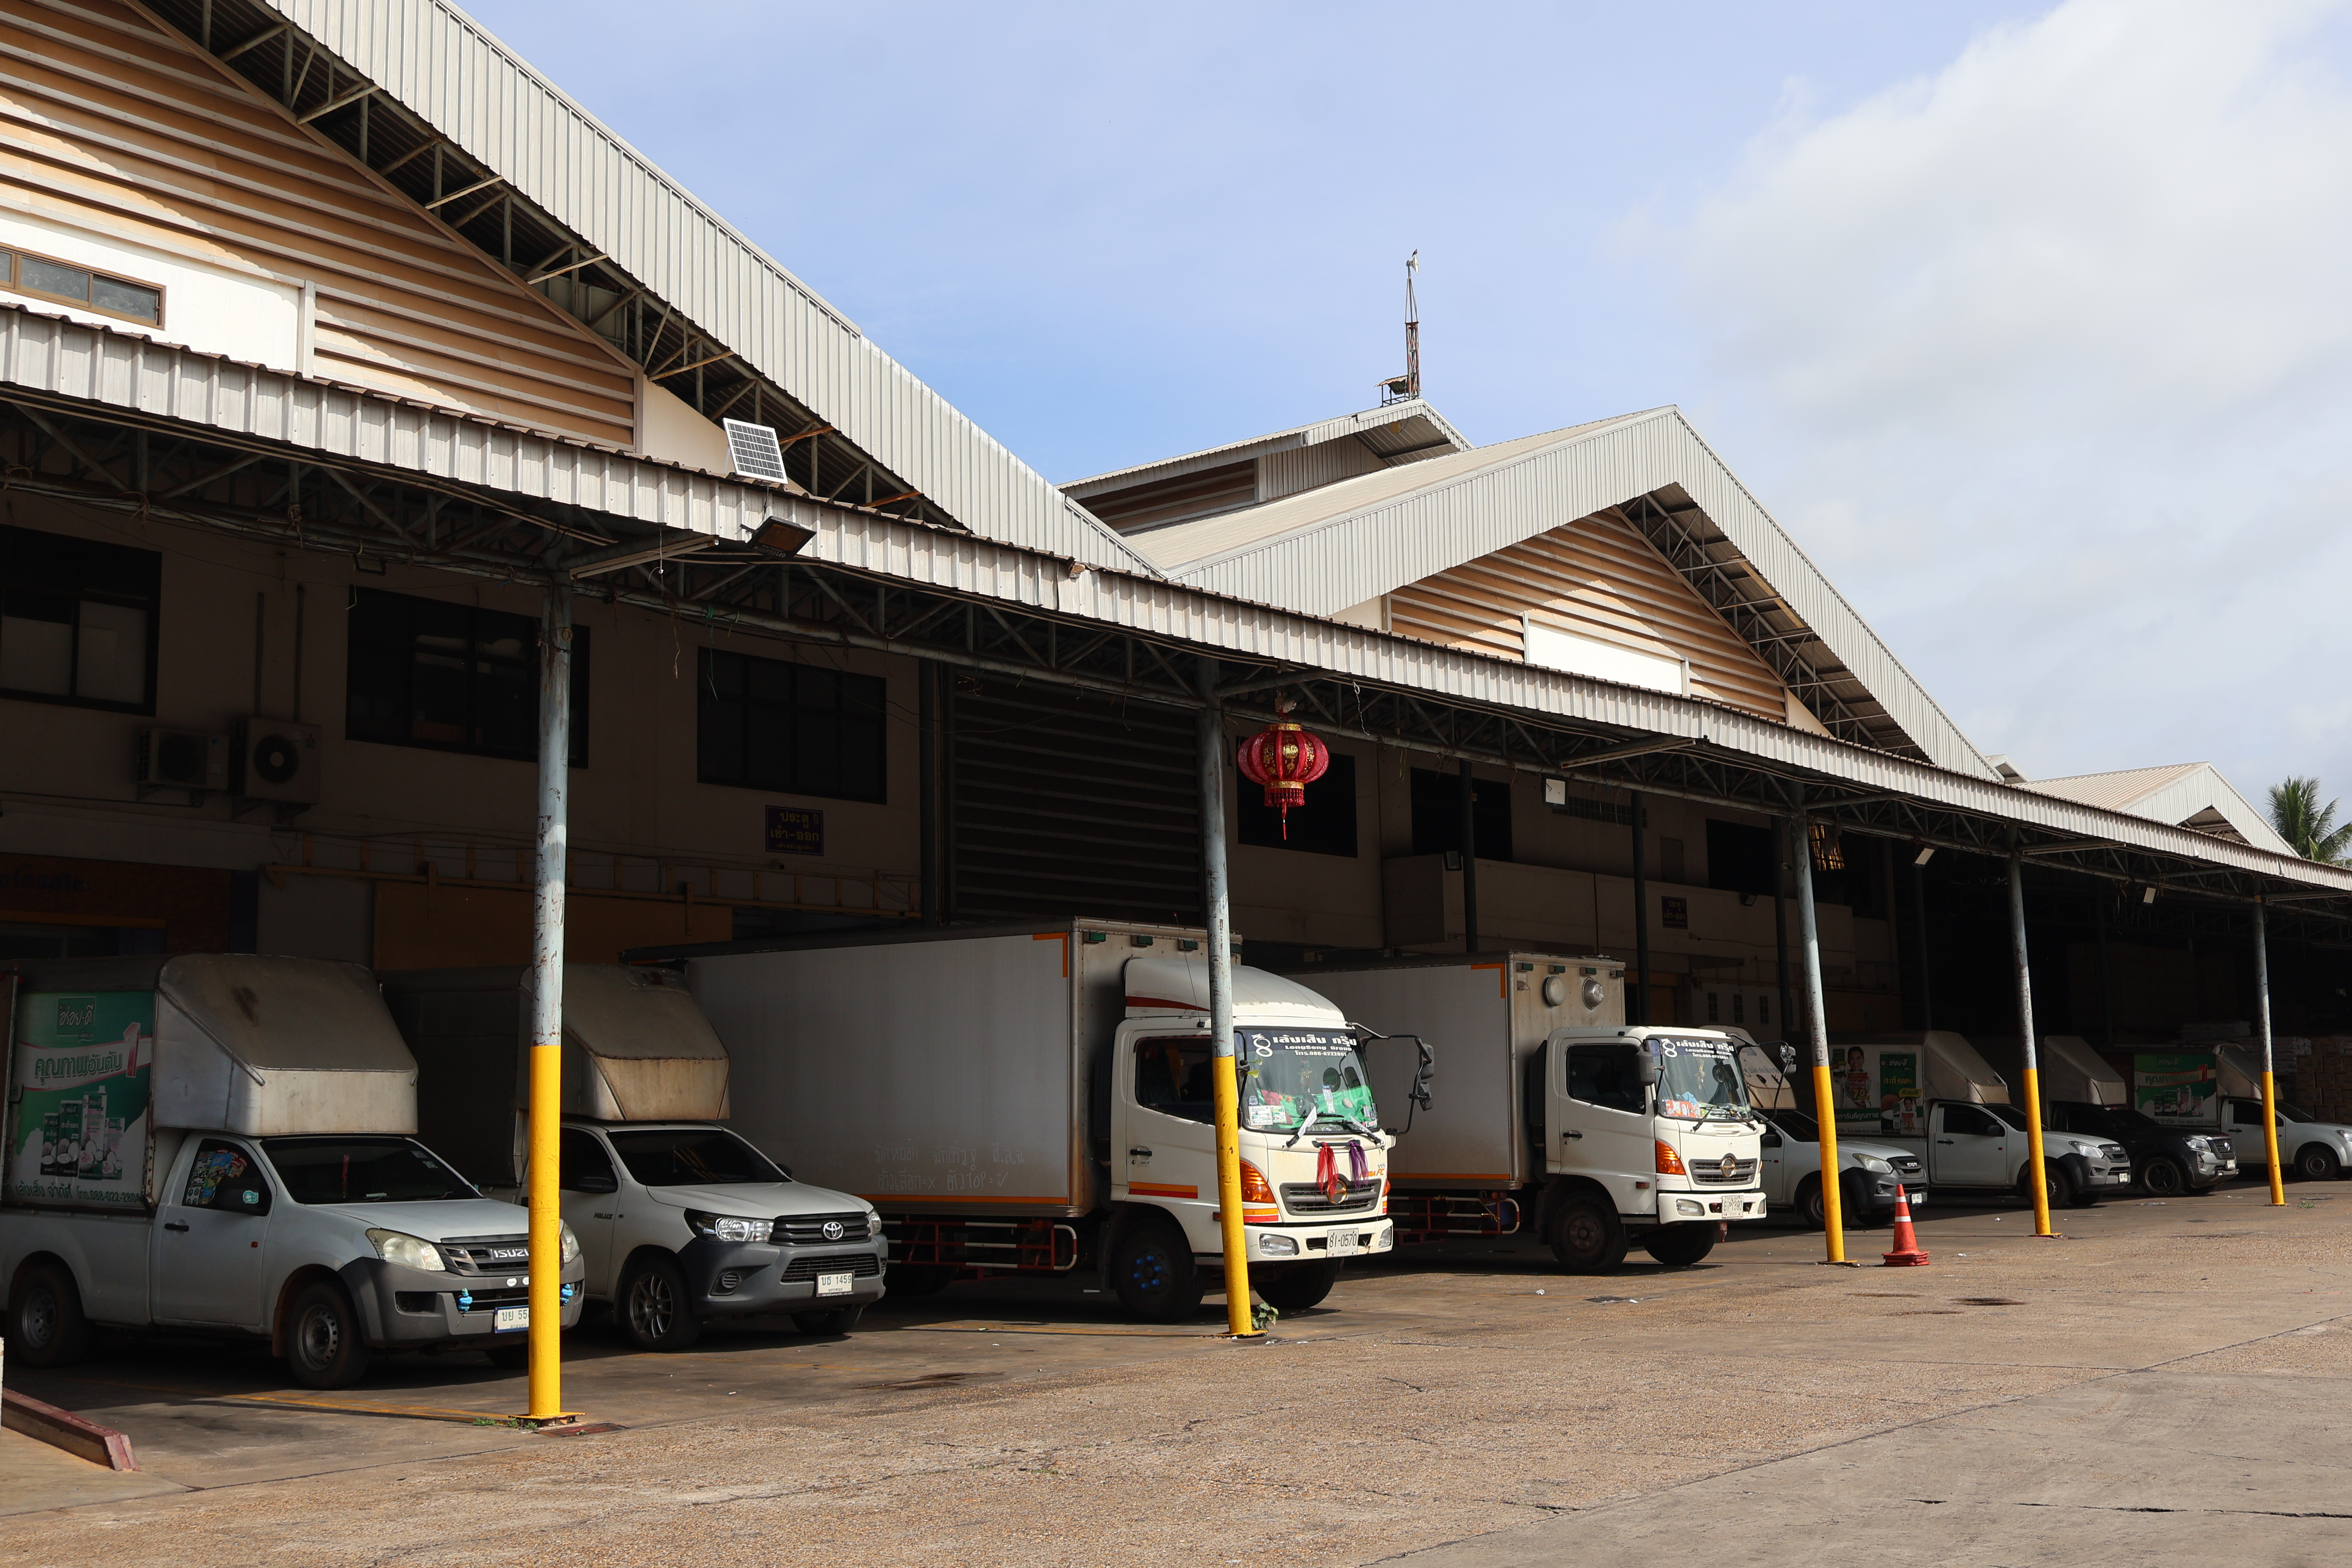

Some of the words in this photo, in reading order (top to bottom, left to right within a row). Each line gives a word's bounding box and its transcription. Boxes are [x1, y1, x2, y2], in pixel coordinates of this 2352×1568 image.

[780, 811, 809, 829] ประตู
[770, 824, 819, 842] เข้า-ออก
[60, 1002, 94, 1026] อร่อย-ดี
[1273, 1034, 1327, 1044] เล้งเส็ง
[1332, 1036, 1357, 1047] กรุ๊ป
[35, 1051, 123, 1085] คุณภาพอันดับ
[123, 1022, 141, 1078] 1
[1329, 1233, 1357, 1248] 81-0570
[836, 1275, 852, 1284] 1459
[502, 1310, 514, 1321] บย
[518, 1309, 529, 1320] 55
